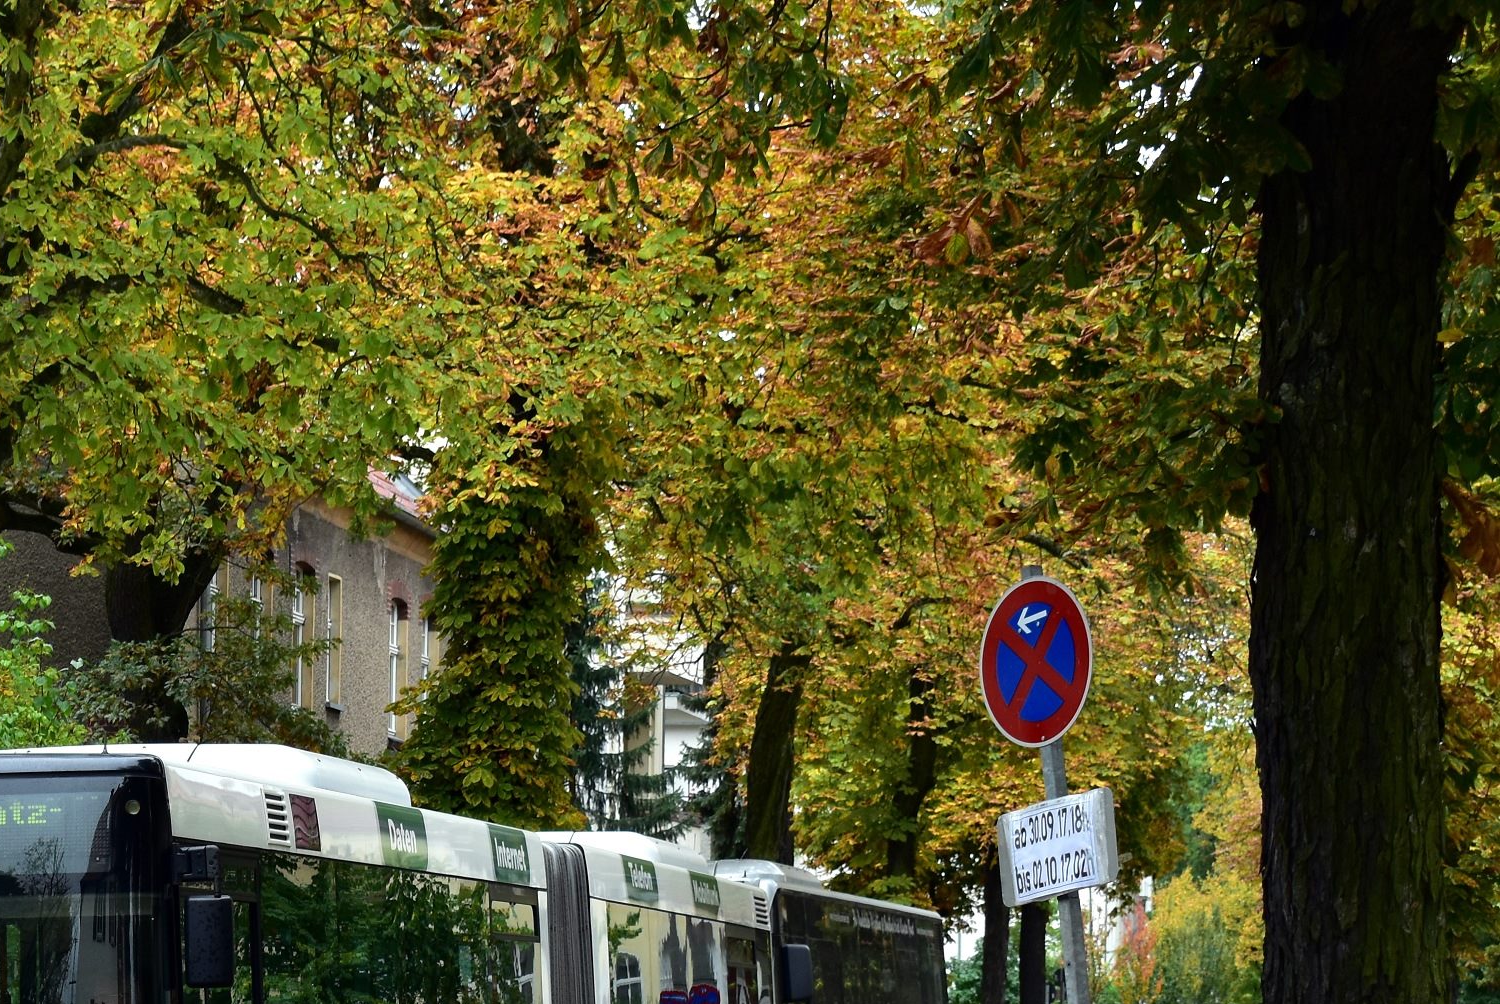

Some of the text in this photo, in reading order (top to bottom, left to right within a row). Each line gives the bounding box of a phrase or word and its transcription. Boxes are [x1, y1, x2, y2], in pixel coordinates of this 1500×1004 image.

[387, 818, 418, 853] Daten
[1014, 820, 1027, 850] ab
[493, 837, 527, 872] Internet
[627, 861, 654, 891] Telefon
[1015, 865, 1031, 895] bis
